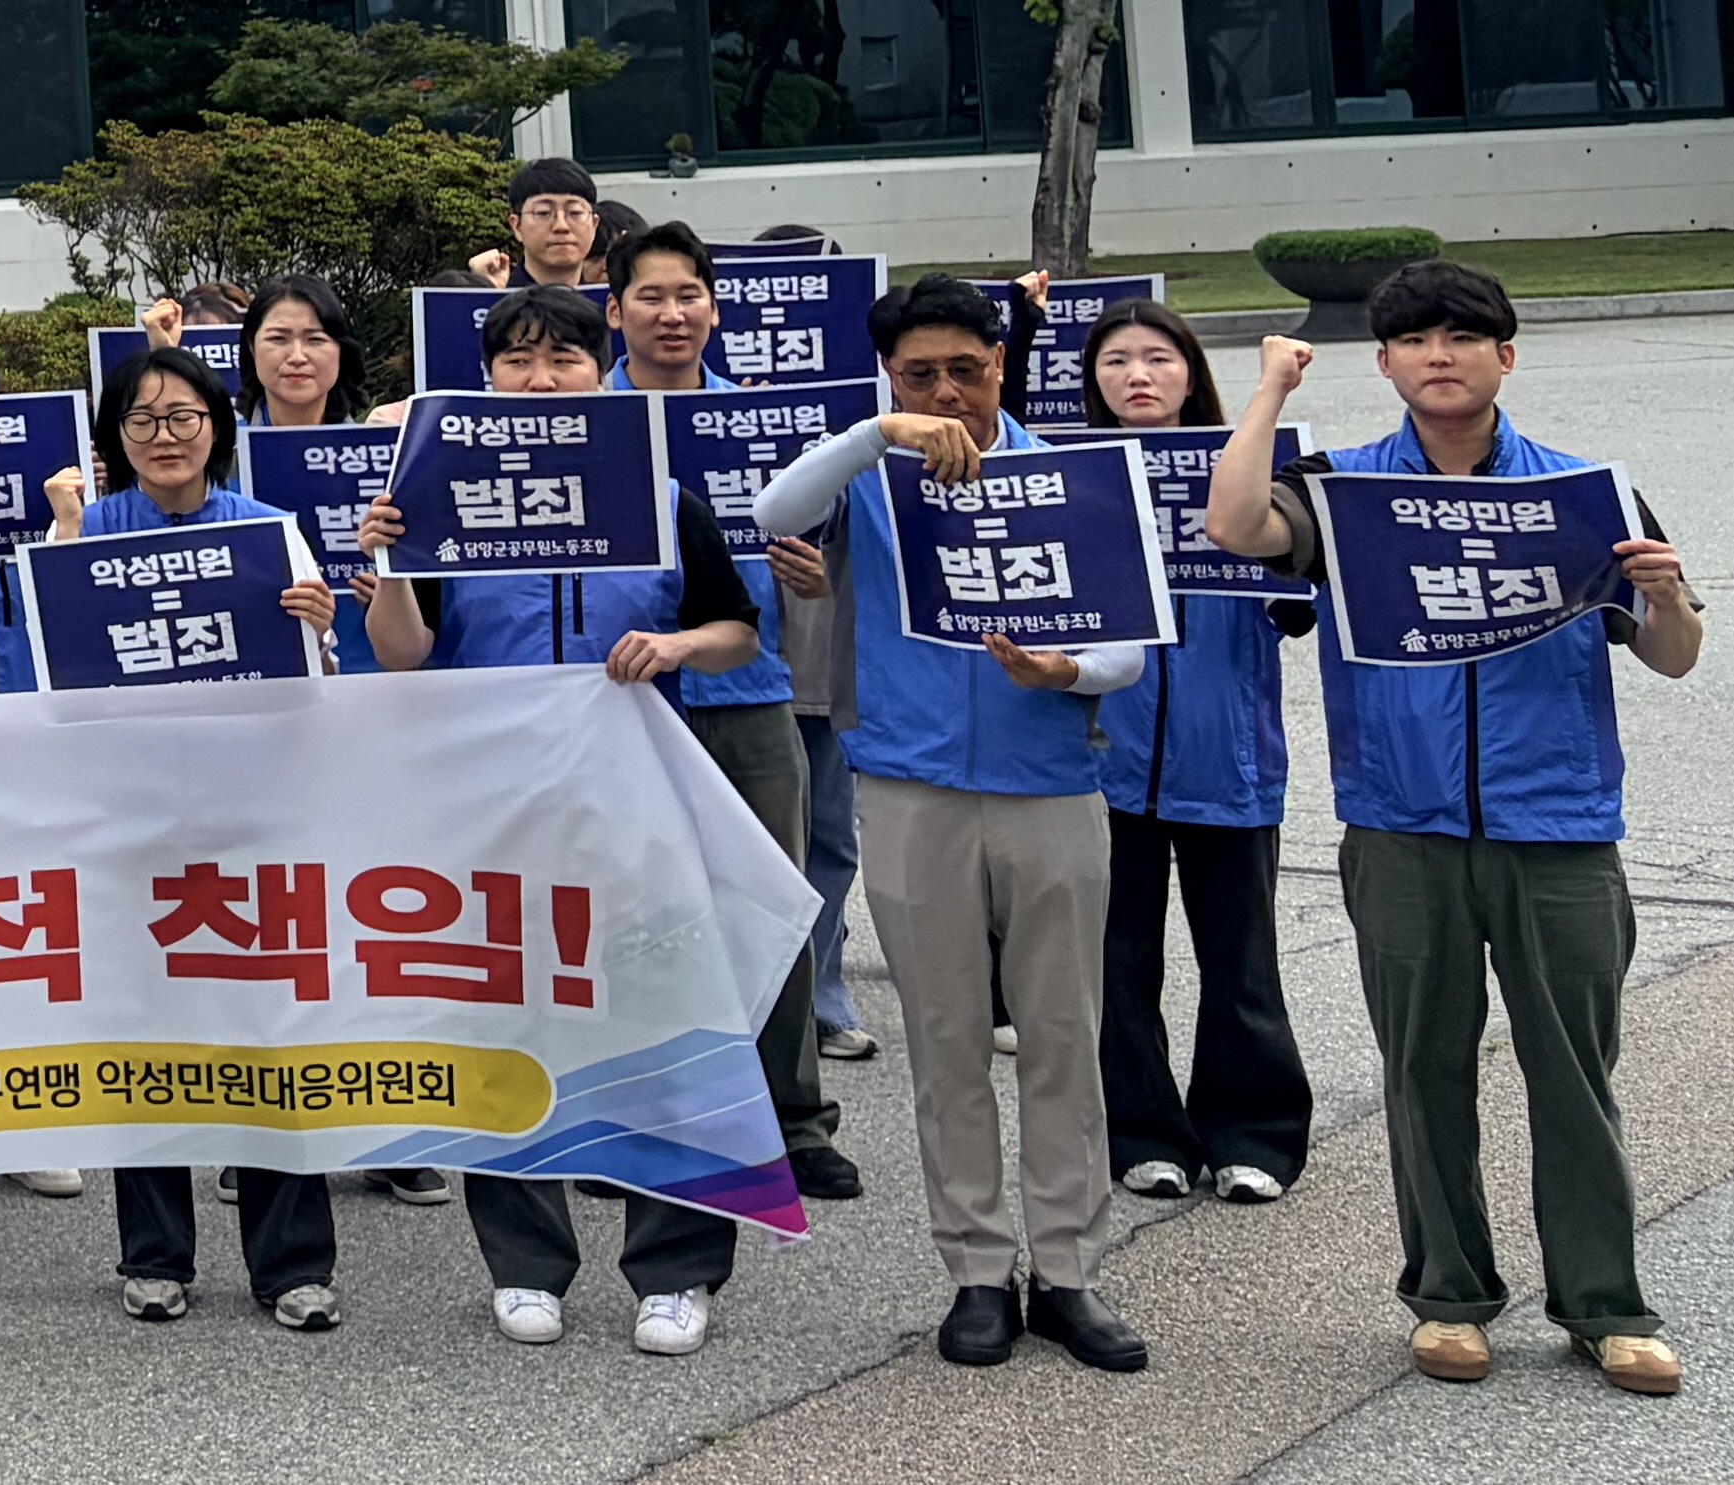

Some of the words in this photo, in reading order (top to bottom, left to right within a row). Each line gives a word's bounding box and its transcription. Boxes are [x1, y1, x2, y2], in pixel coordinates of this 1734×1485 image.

[714, 274, 828, 304] 악성민원
[722, 327, 825, 375] 범죄
[441, 414, 589, 447] 악성민원
[692, 403, 828, 438] 악성민원
[304, 444, 396, 475] 악성민
[451, 476, 586, 529] 범죄
[919, 471, 1067, 513] 악성민원
[1391, 498, 1558, 533] 악성민원
[90, 545, 235, 590] 악성민원
[464, 538, 609, 559] 담양군공무원노동조합
[936, 541, 1074, 602] 범죄
[1165, 563, 1265, 581] 공무원노동조합
[1410, 565, 1564, 621] 범죄
[107, 611, 242, 676] 범죄
[955, 611, 1103, 634] 담양군공무원노동조합
[1431, 601, 1583, 650] 담양군공무원노
[147, 861, 595, 1011] 책임!
[96, 1059, 456, 1112] 악성민원대응위원회
